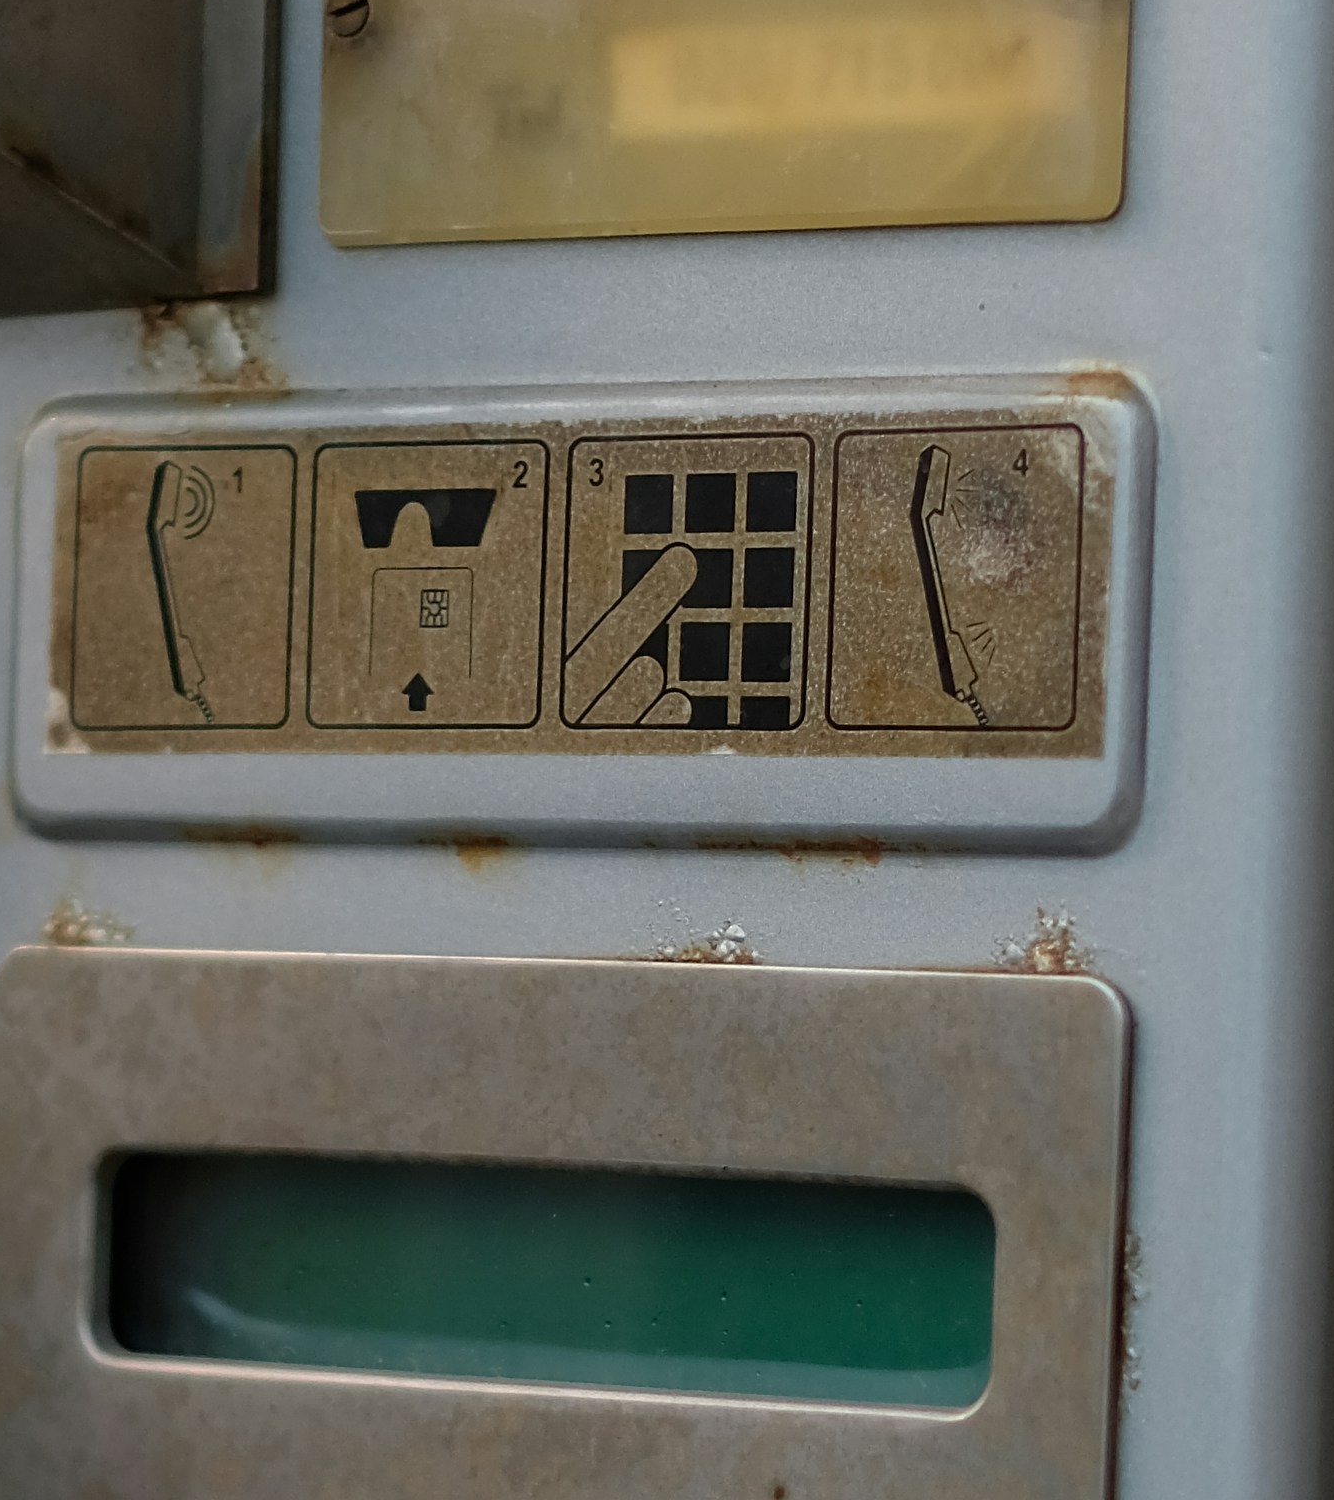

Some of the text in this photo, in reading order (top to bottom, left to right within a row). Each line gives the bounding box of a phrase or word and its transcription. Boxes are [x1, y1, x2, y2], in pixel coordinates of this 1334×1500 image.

[512, 460, 528, 488] 2
[589, 458, 604, 487] 3
[1012, 448, 1029, 477] 4
[232, 466, 243, 494] 1
